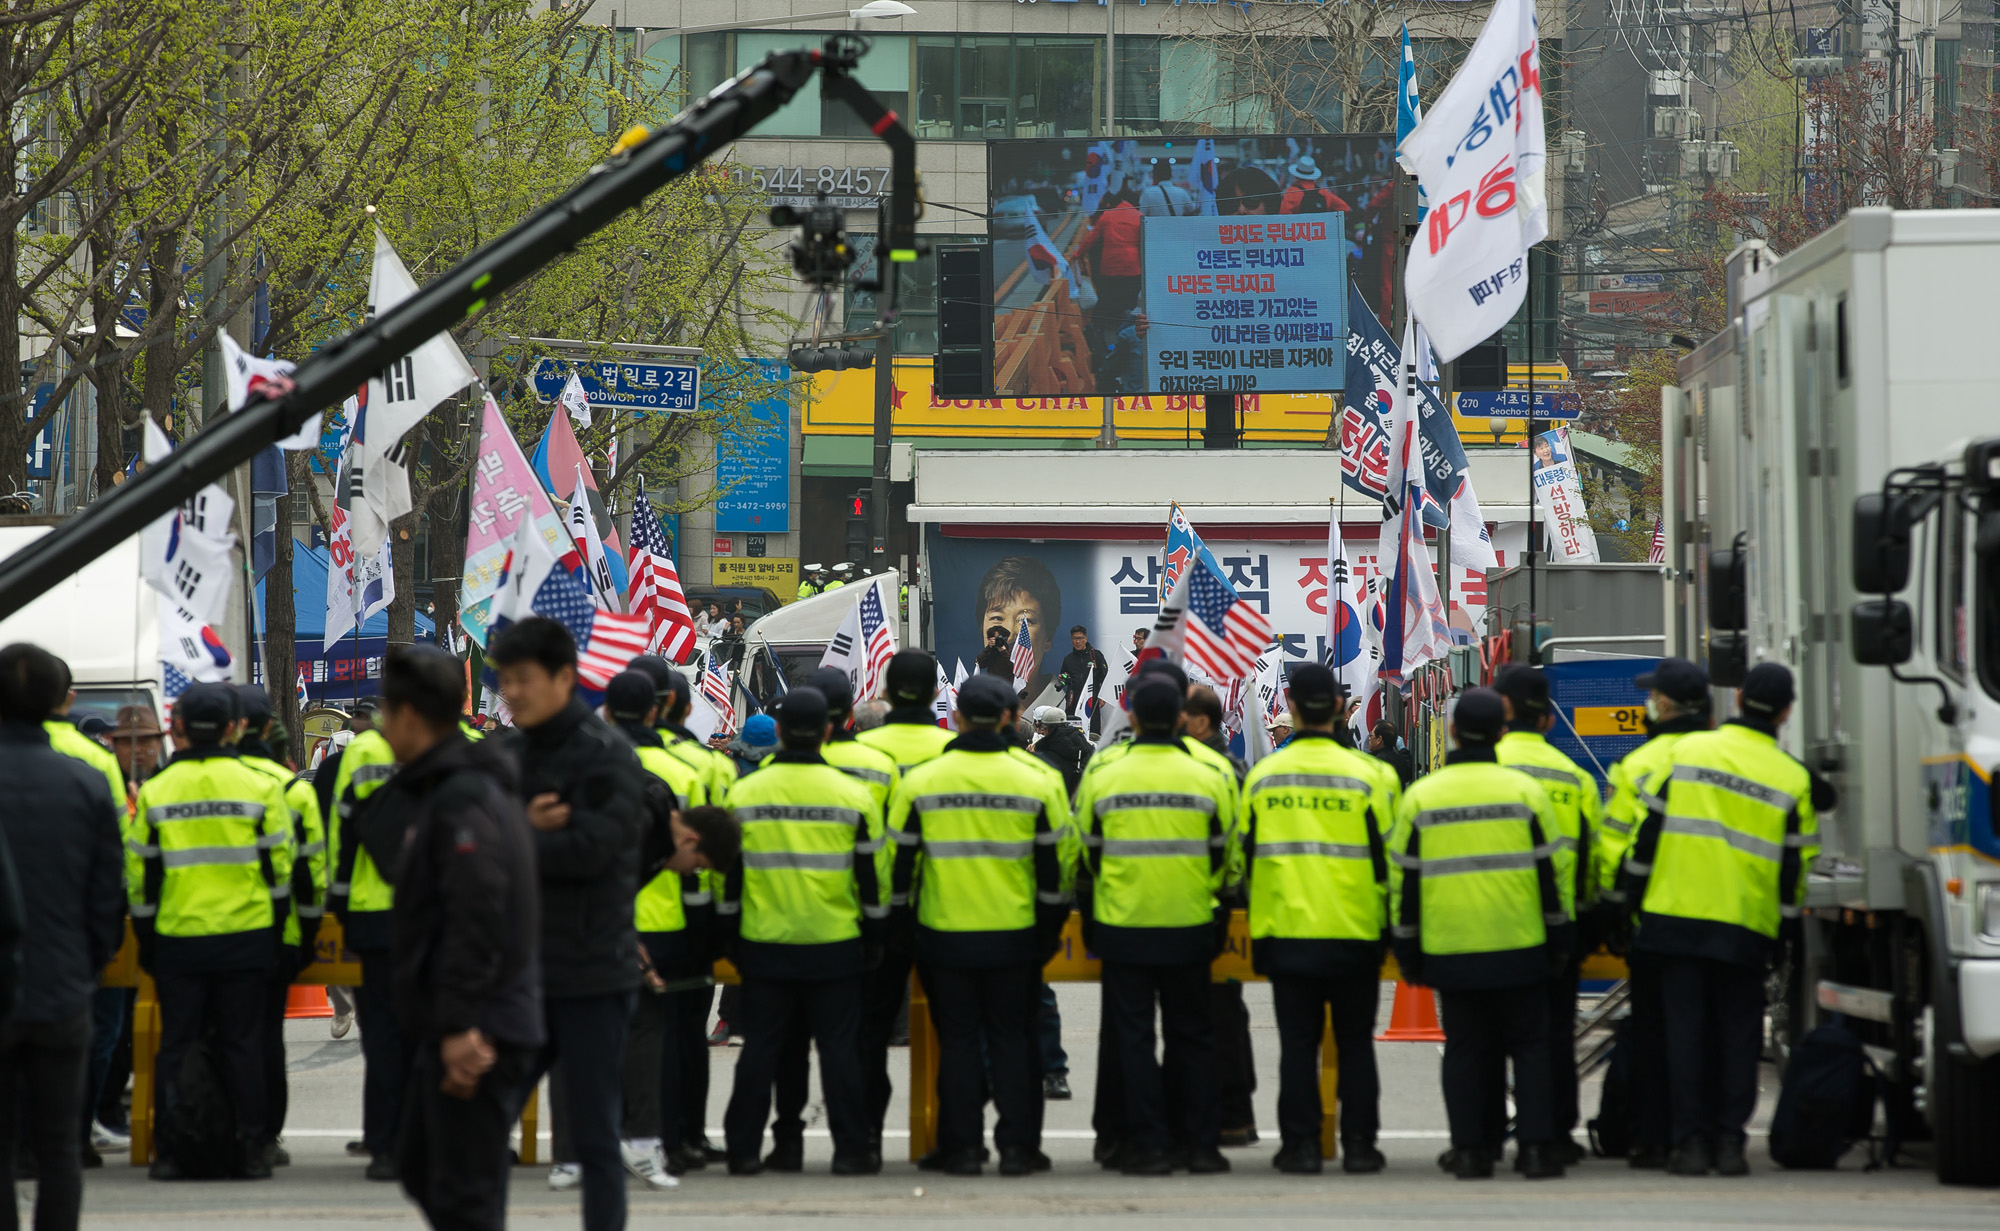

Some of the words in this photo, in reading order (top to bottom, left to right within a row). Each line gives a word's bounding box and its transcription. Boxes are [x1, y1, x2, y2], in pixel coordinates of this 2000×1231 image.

[734, 165, 891, 195] 1544-8457
[1219, 224, 1263, 244] 법치도
[1267, 222, 1326, 243] 무너지고
[1197, 249, 1242, 269] 언론도
[1246, 248, 1304, 268] 무너지고
[1167, 275, 1213, 294] 나라도
[1216, 273, 1275, 293] 무너지고
[1196, 299, 1255, 320] 공산화로
[1259, 298, 1318, 318] 가고있는
[1158, 350, 1189, 370] 우리
[1192, 350, 1236, 370] 국민이
[1240, 349, 1285, 369] 나라를
[1288, 347, 1333, 367] 지켜야
[584, 389, 657, 404] eobwon-ro
[660, 392, 691, 408] 2-gil
[1462, 398, 1479, 408] 270
[718, 502, 787, 510] 02-3472-5959
[1550, 484, 1581, 556] 석방하라
[748, 536, 765, 545] 270
[729, 563, 746, 573] 직원
[748, 563, 756, 573] 및
[758, 563, 774, 573] 알바
[776, 563, 793, 573] 모집
[1110, 554, 1270, 615] 살적
[334, 656, 384, 682] 모집합
[1698, 768, 1775, 800] POLICE
[165, 801, 245, 819] POLICE
[939, 794, 1018, 809] POLICE
[1115, 793, 1197, 809] POLICE
[1267, 795, 1351, 812] POLICE
[755, 807, 835, 821] POLICE
